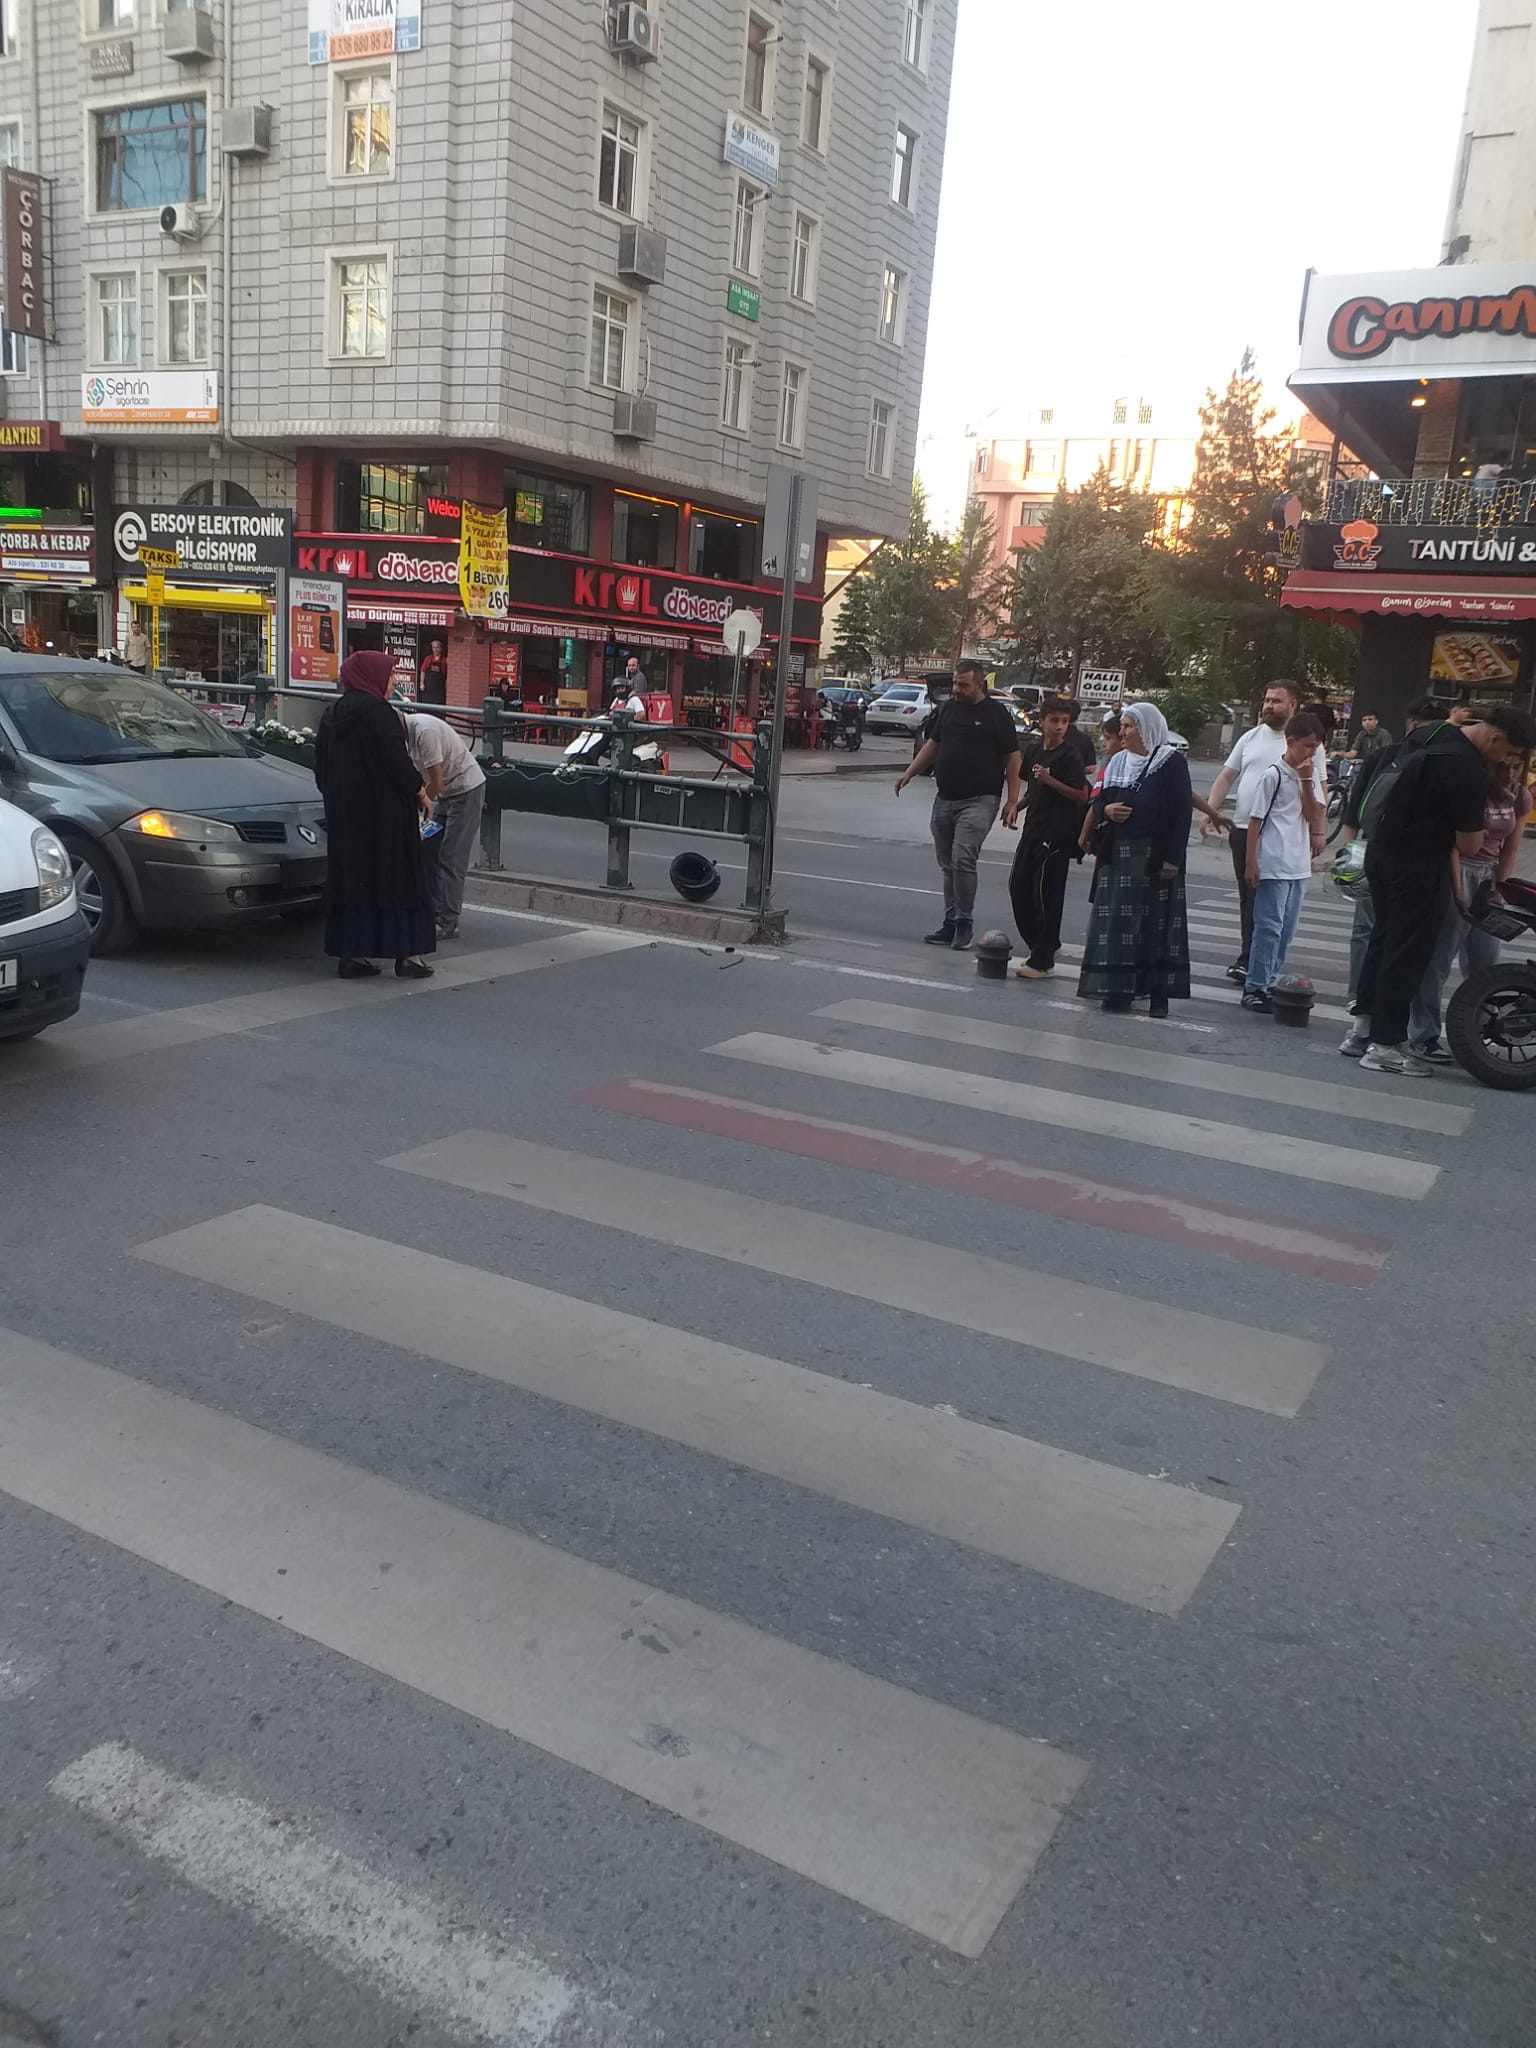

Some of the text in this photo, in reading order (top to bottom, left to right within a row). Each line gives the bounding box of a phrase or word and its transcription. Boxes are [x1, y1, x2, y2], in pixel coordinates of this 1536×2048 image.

[19, 190, 34, 328] ÇORBACI
[105, 377, 150, 399] Şehrin
[427, 497, 460, 518] Welco
[150, 512, 285, 537] ERSOY ELEKTRONİK
[0, 532, 90, 552] ÇORBA & KEBAP
[176, 536, 257, 562] BİLGİSAYAR
[1409, 536, 1536, 562] TANTUNİ &
[140, 549, 178, 565] TAKSİ
[464, 562, 471, 584] 1
[368, 610, 403, 622] Dürüm
[395, 657, 416, 670] ANA
[1083, 682, 1119, 692] OĞLU
